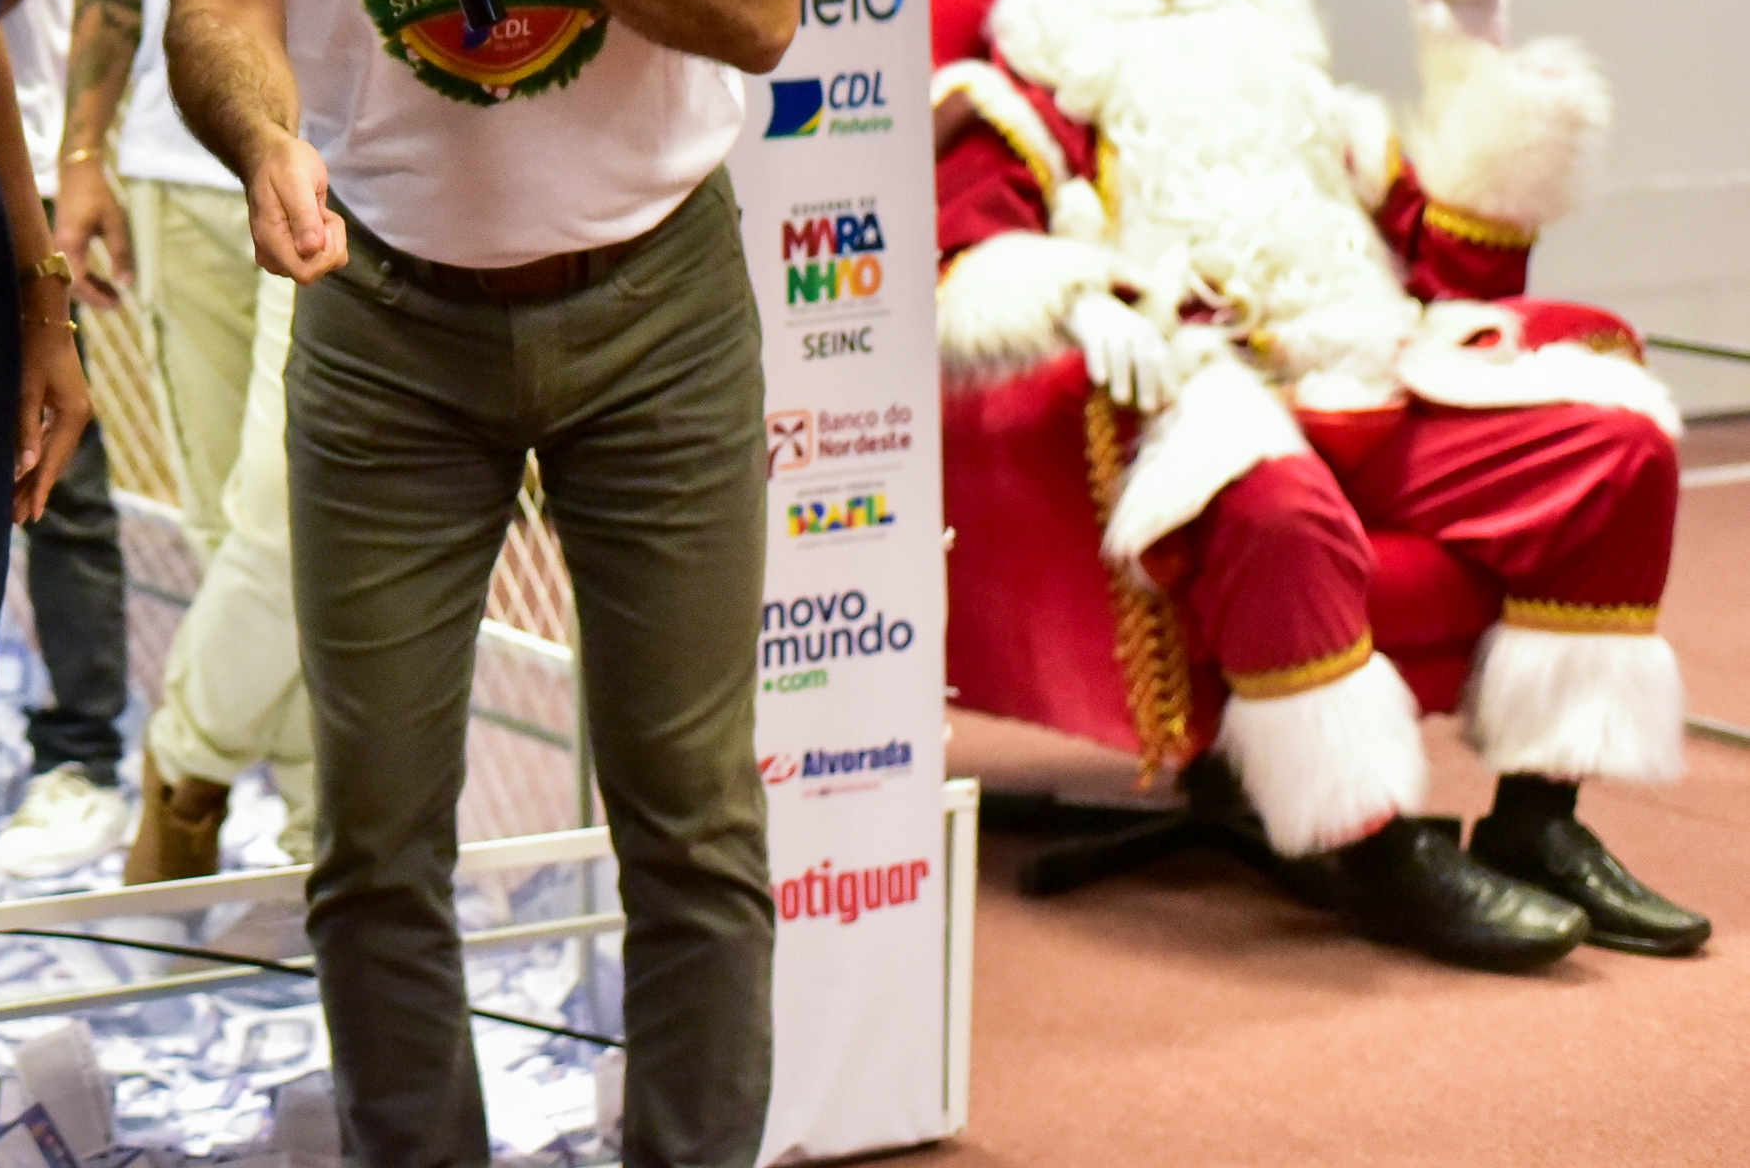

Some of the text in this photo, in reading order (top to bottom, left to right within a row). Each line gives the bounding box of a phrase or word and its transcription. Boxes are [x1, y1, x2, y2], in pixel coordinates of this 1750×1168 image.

[829, 70, 886, 110] CDL
[802, 327, 874, 360] SEINC
[818, 402, 913, 433] Banco do
[818, 432, 912, 459] Nordeste
[763, 589, 867, 633] novo
[764, 612, 914, 669] mundo
[802, 739, 913, 779] Alvorada
[774, 859, 930, 925] otiguar
